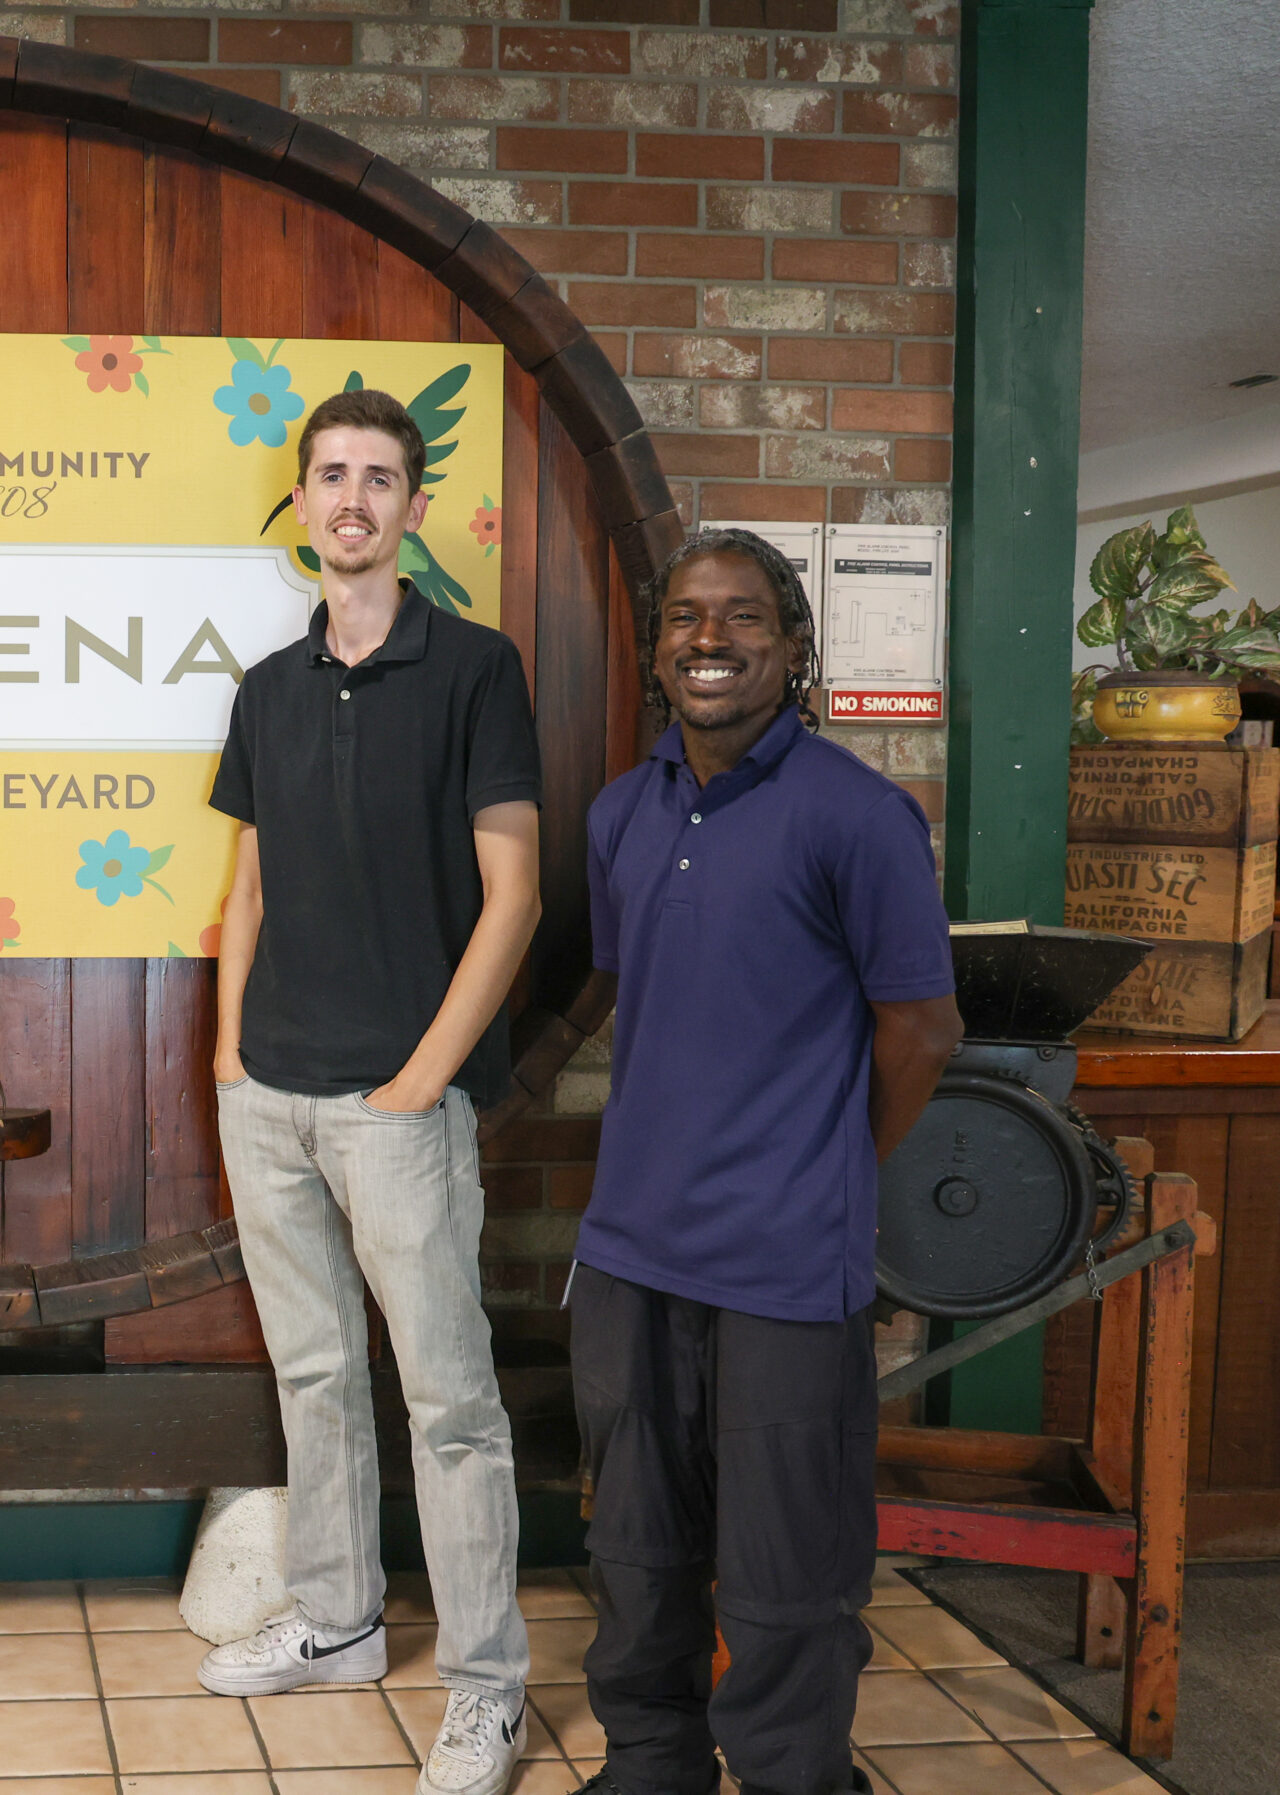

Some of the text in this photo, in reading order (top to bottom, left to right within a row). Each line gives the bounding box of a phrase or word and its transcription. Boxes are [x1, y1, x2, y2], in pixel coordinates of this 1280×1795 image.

[834, 696, 939, 712] NO SMOKING
[1070, 756, 1199, 769] CHAMPAGNE
[1122, 788, 1216, 825] GOLDEN
[1146, 863, 1207, 906] SEC
